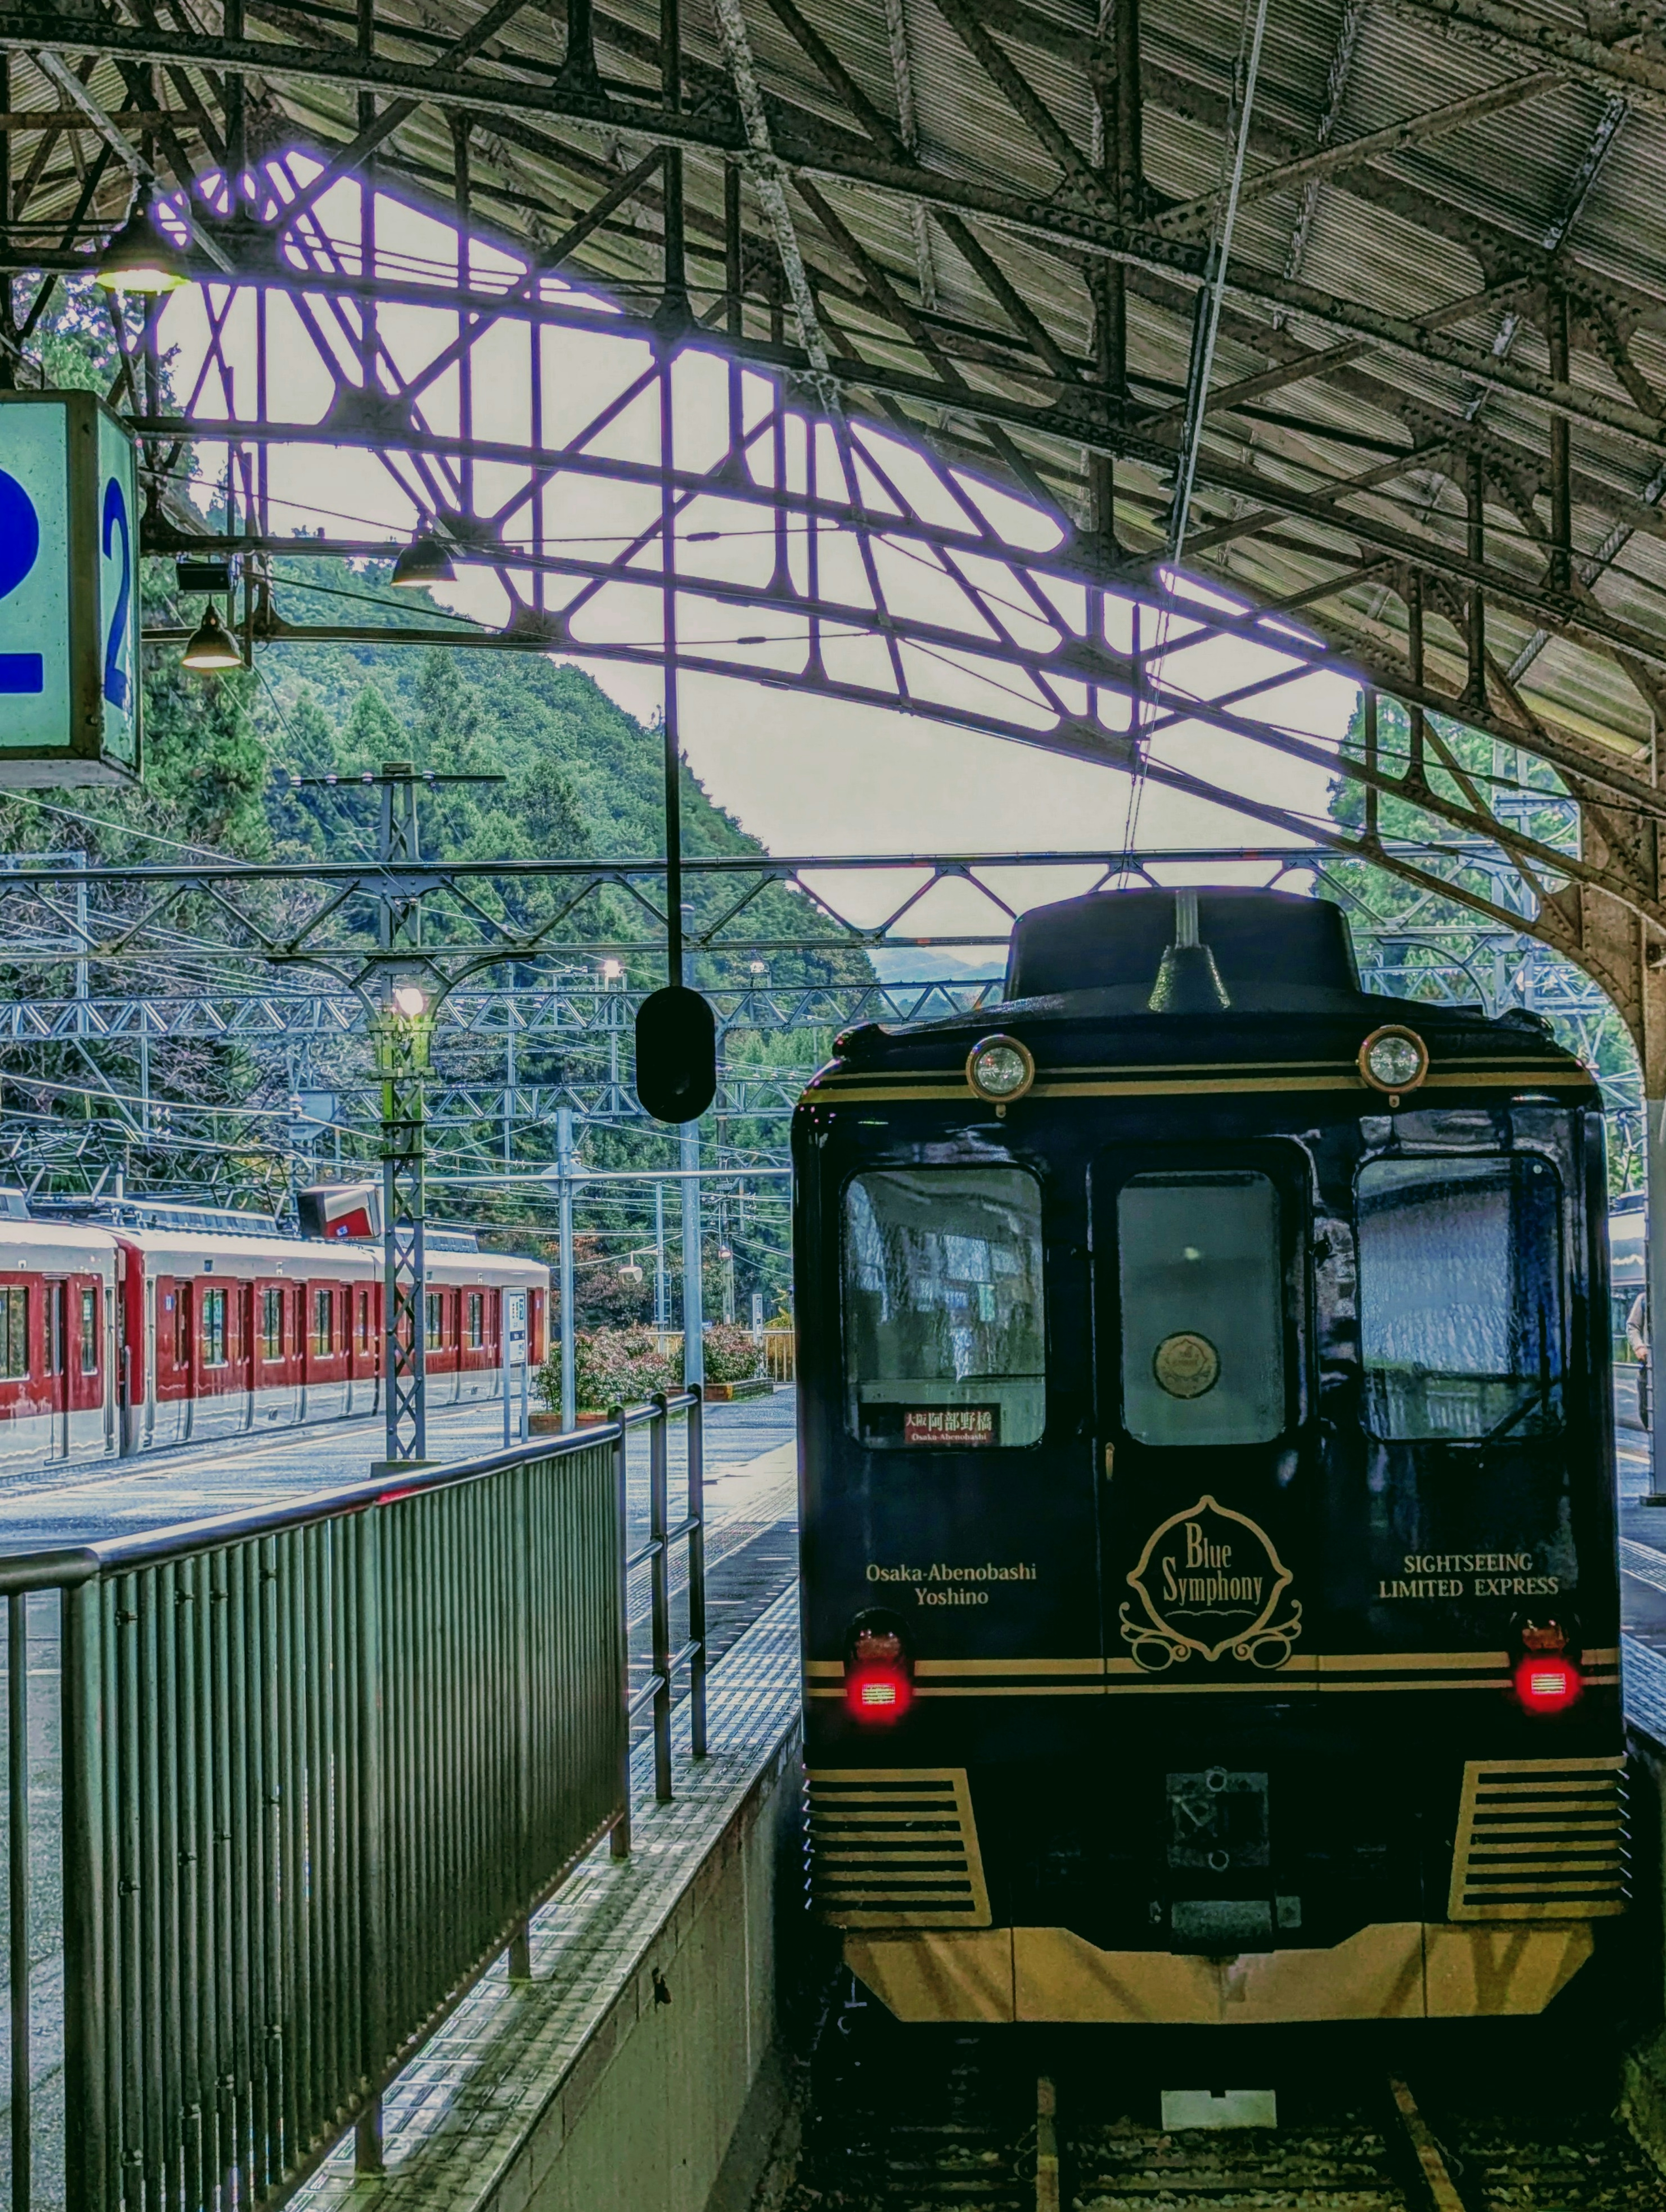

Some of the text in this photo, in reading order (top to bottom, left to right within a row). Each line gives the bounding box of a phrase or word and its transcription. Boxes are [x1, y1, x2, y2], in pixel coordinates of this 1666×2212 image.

[102, 476, 134, 718] 2
[912, 1433, 987, 1441] Osaka-Abenobashi
[1184, 1522, 1232, 1568] Blue
[866, 1563, 1036, 1581] Osaka-Abenobashi
[1404, 1553, 1533, 1574] SIGHTSEEING
[1162, 1556, 1263, 1606] Symphony
[1379, 1577, 1559, 1598] LIMITED EXPRESS
[915, 1588, 989, 1605] Yoshino
